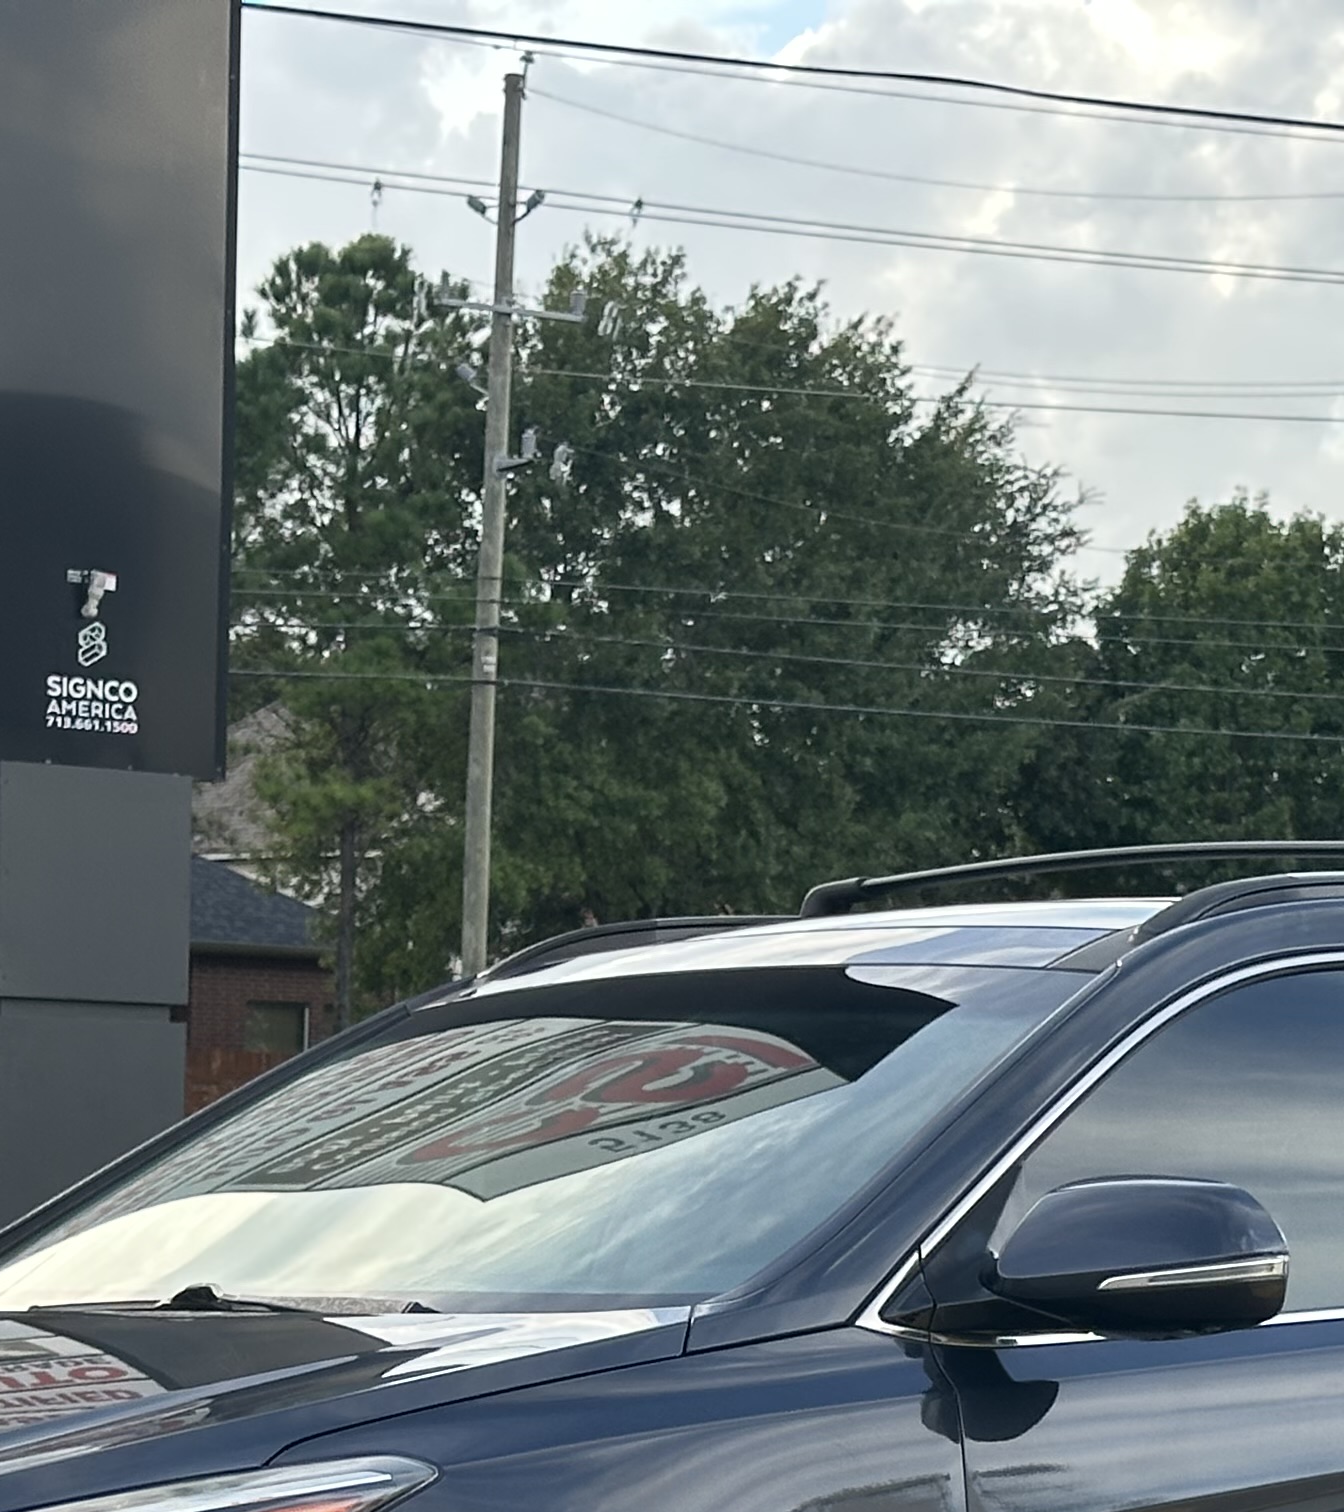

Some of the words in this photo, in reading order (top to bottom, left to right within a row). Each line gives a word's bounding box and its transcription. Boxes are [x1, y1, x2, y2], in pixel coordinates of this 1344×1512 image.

[46, 675, 138, 702] SIGNCO
[46, 699, 138, 721] AMERICA
[46, 715, 138, 734] 713.661.1500
